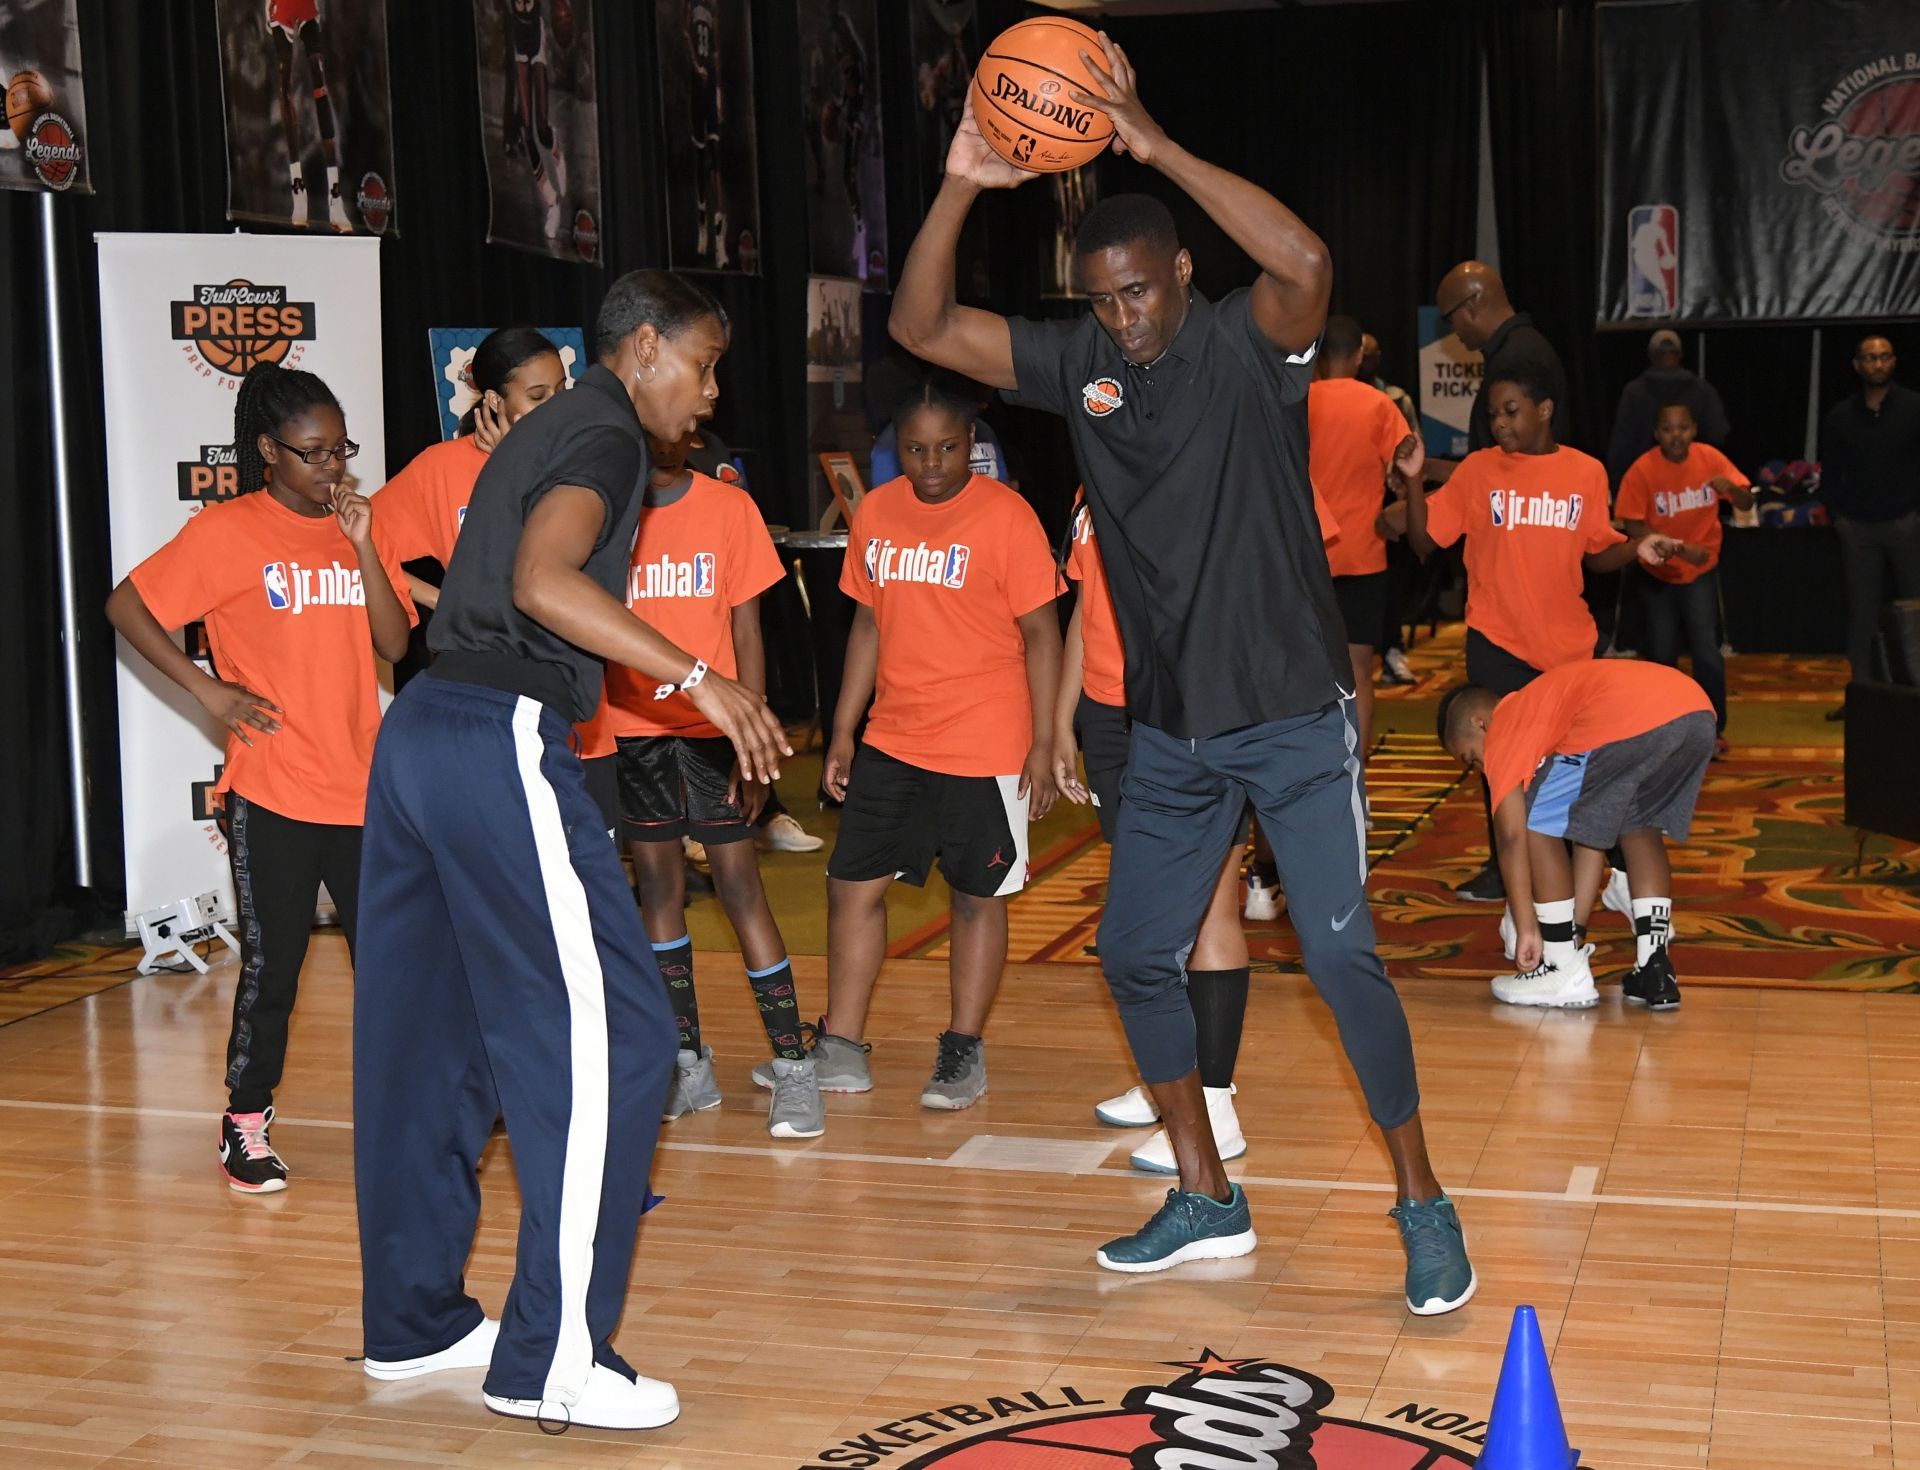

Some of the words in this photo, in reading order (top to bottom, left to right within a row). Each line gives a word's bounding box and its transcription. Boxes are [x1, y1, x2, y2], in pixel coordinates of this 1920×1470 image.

[991, 72, 1095, 136] SPALDING
[1821, 55, 1901, 114] NATIONAL
[26, 137, 80, 164] Legends
[201, 287, 237, 305] Full
[235, 287, 281, 305] Court
[184, 306, 303, 336] PRESS
[182, 345, 212, 377] PREP
[191, 466, 238, 496] PR
[1507, 489, 1568, 530] jr.nba
[878, 539, 945, 588] jr.nba
[290, 561, 366, 614] jr.nba
[798, 1386, 1105, 1470] SKETBALL
